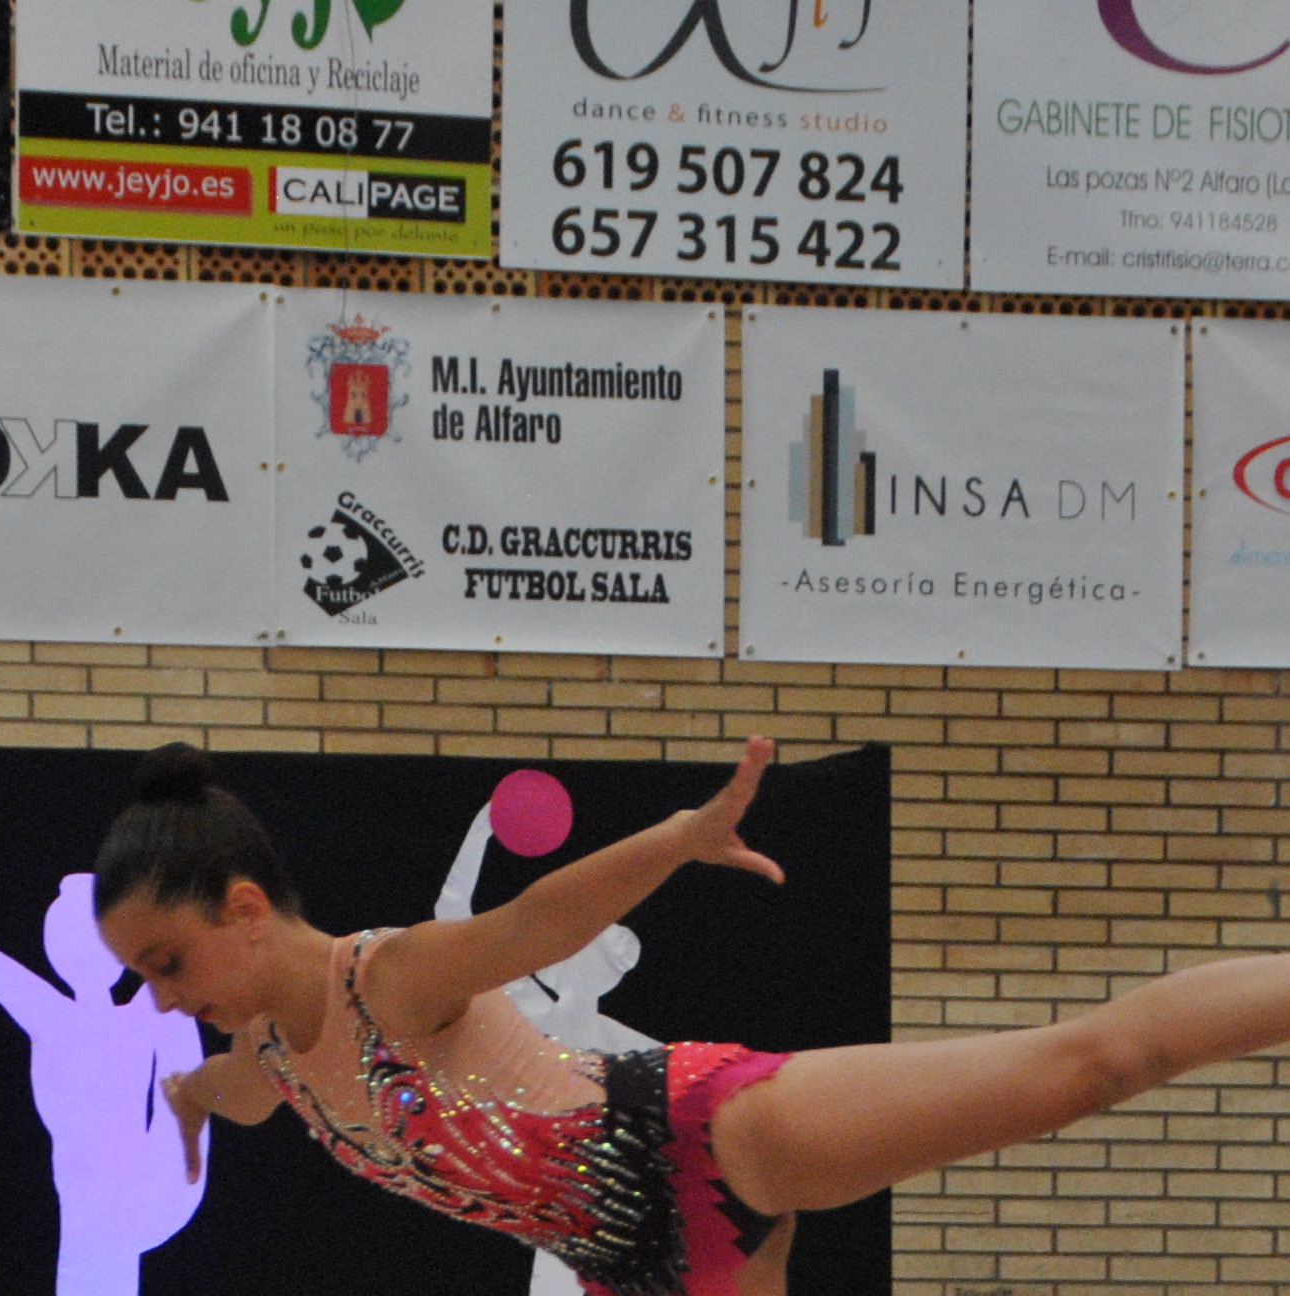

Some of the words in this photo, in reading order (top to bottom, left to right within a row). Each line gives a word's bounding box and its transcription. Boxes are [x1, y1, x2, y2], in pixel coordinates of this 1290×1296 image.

[97, 43, 191, 81] Material
[198, 50, 223, 82] de
[230, 52, 301, 87] oficina
[306, 67, 320, 95] y
[327, 57, 420, 100] Reciclaje
[178, 107, 244, 143] 941
[261, 112, 302, 146] 18
[315, 116, 359, 149] 08
[373, 120, 415, 152] 77
[572, 97, 657, 122] dance
[696, 103, 788, 128] fitness
[799, 111, 889, 134] studio
[996, 98, 1141, 140] GABINETE
[1152, 103, 1192, 141] DE
[31, 162, 236, 203] www.jeyjo.es
[552, 138, 659, 191] 619
[676, 144, 782, 198] 507
[797, 151, 905, 203] 824
[1046, 165, 1079, 190] Las
[1085, 170, 1148, 194] pozas
[1200, 171, 1260, 196] Alfaro
[283, 178, 460, 213] CALIPAGE
[551, 206, 658, 258] 657
[676, 212, 780, 265] 315
[796, 219, 902, 271] 422
[431, 355, 487, 396] M.I.
[497, 358, 683, 403] Ayuntamiento
[432, 403, 464, 441] de
[474, 404, 562, 444] Alfaro
[889, 474, 1031, 519] INSA
[1057, 479, 1137, 522] DM
[337, 490, 426, 579] Graccurris
[441, 524, 493, 555] C.D.
[500, 525, 693, 562] GRACCURRIS
[464, 568, 585, 601] FUTBOL
[591, 571, 670, 604] SALA
